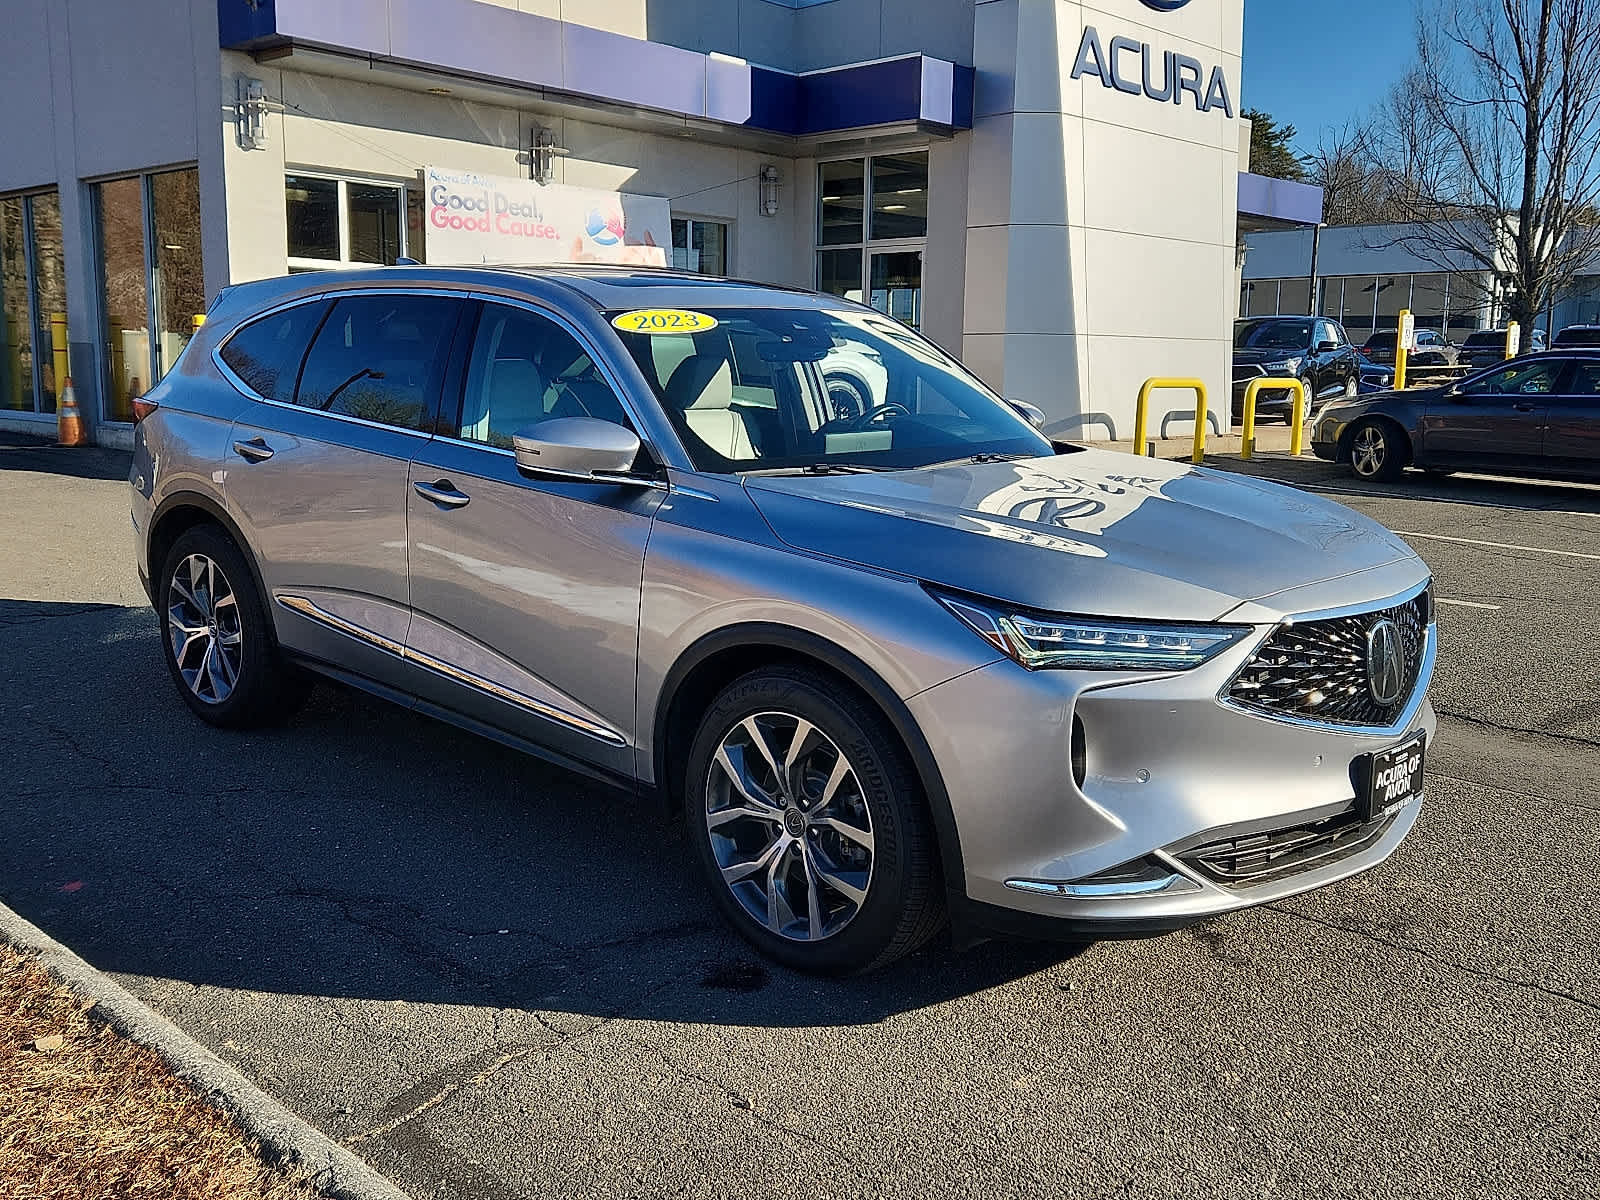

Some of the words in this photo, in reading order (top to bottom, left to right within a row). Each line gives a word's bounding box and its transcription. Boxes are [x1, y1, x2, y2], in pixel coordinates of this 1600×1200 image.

[1070, 25, 1233, 118] ACURA
[430, 184, 489, 213] Good
[494, 191, 543, 222] Deal,
[430, 205, 491, 232] Good
[495, 211, 561, 240] Cause.
[634, 314, 699, 329] 2023
[1376, 762, 1408, 790] ACURA
[1408, 754, 1421, 774] OF
[1384, 774, 1412, 802] AVON
